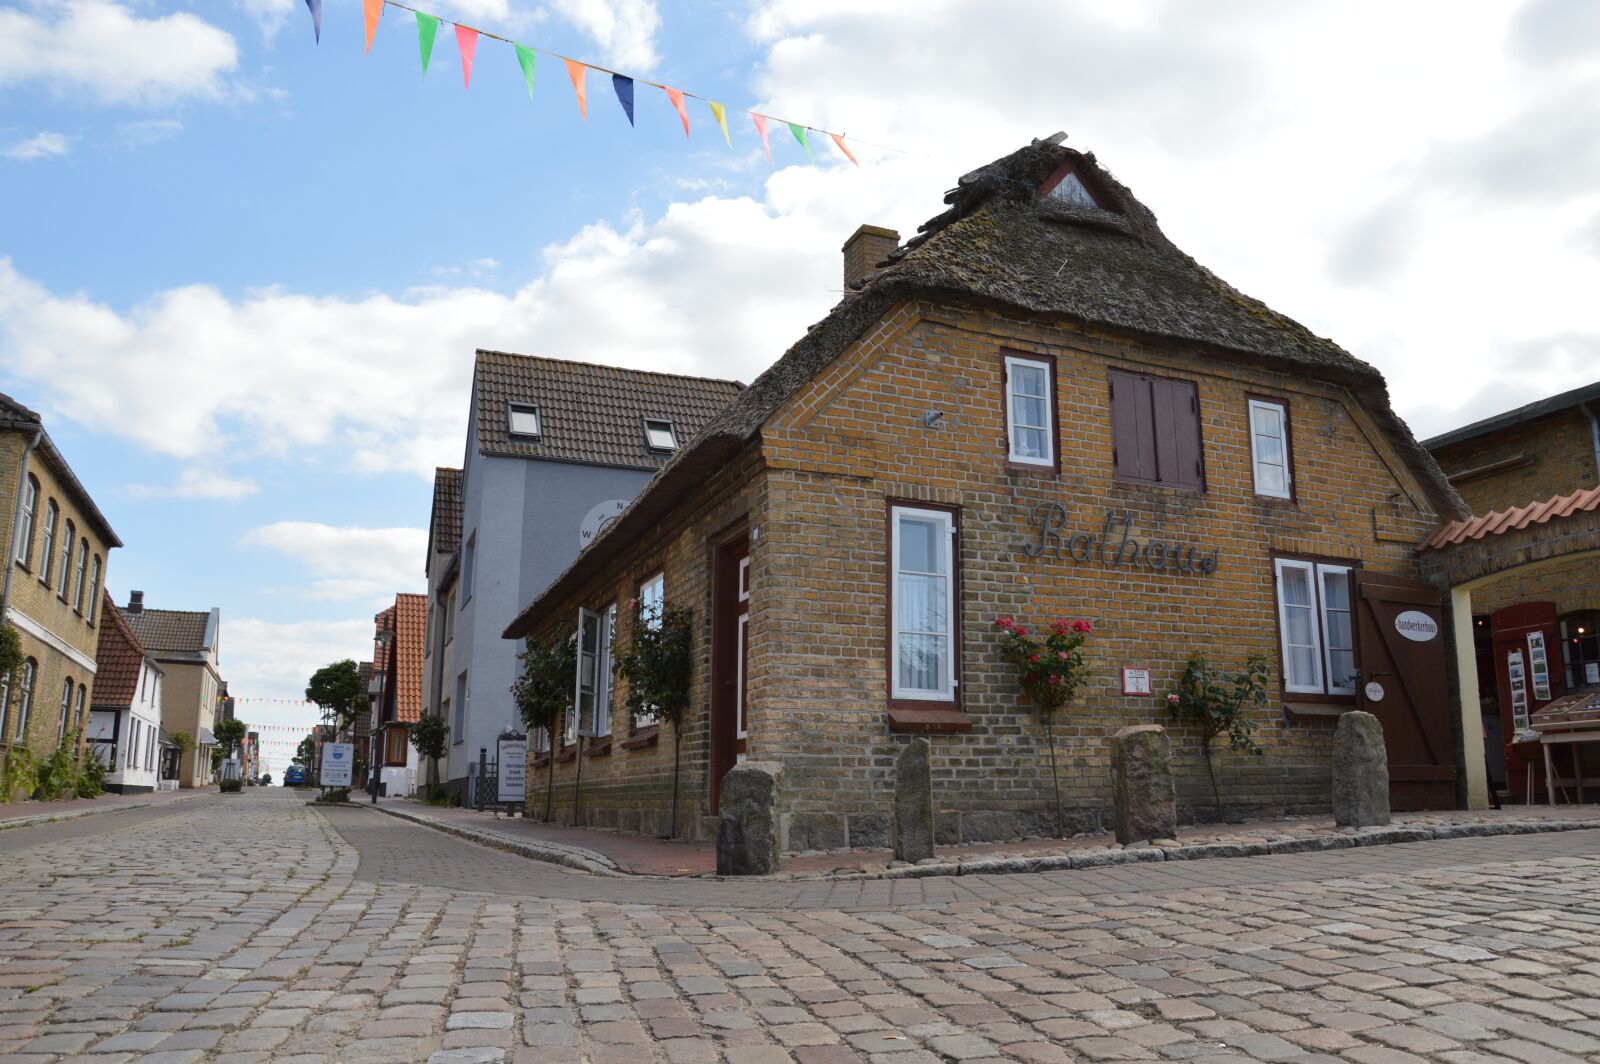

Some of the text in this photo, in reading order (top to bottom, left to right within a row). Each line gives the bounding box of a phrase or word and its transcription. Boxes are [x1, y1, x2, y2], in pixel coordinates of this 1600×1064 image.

[616, 502, 624, 510] N
[582, 530, 592, 539] W
[1024, 501, 1220, 574] Rathaus
